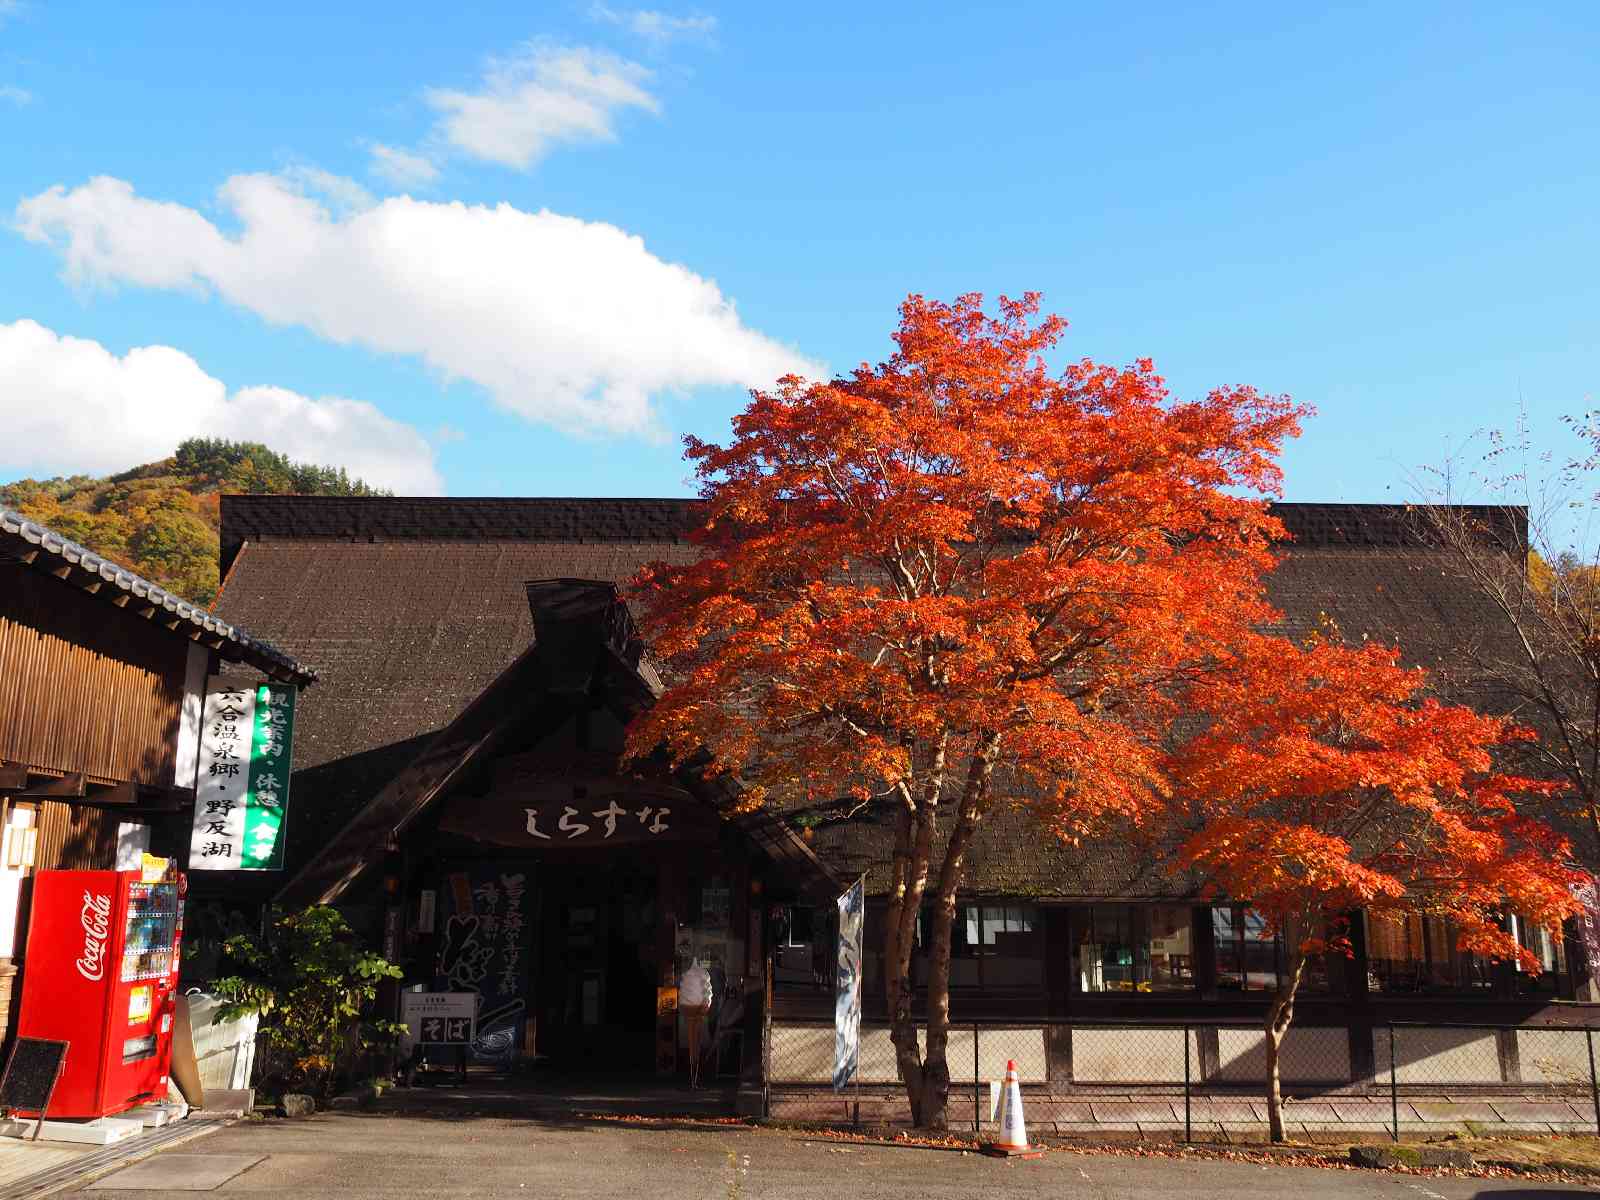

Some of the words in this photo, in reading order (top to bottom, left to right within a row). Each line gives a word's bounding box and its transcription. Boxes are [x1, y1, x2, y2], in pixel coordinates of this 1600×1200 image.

[202, 686, 246, 857] 六合温泉郷・野反湖
[523, 800, 671, 840] しらすな
[76, 889, 111, 982] Coca-Cola
[424, 1018, 470, 1041] そば
